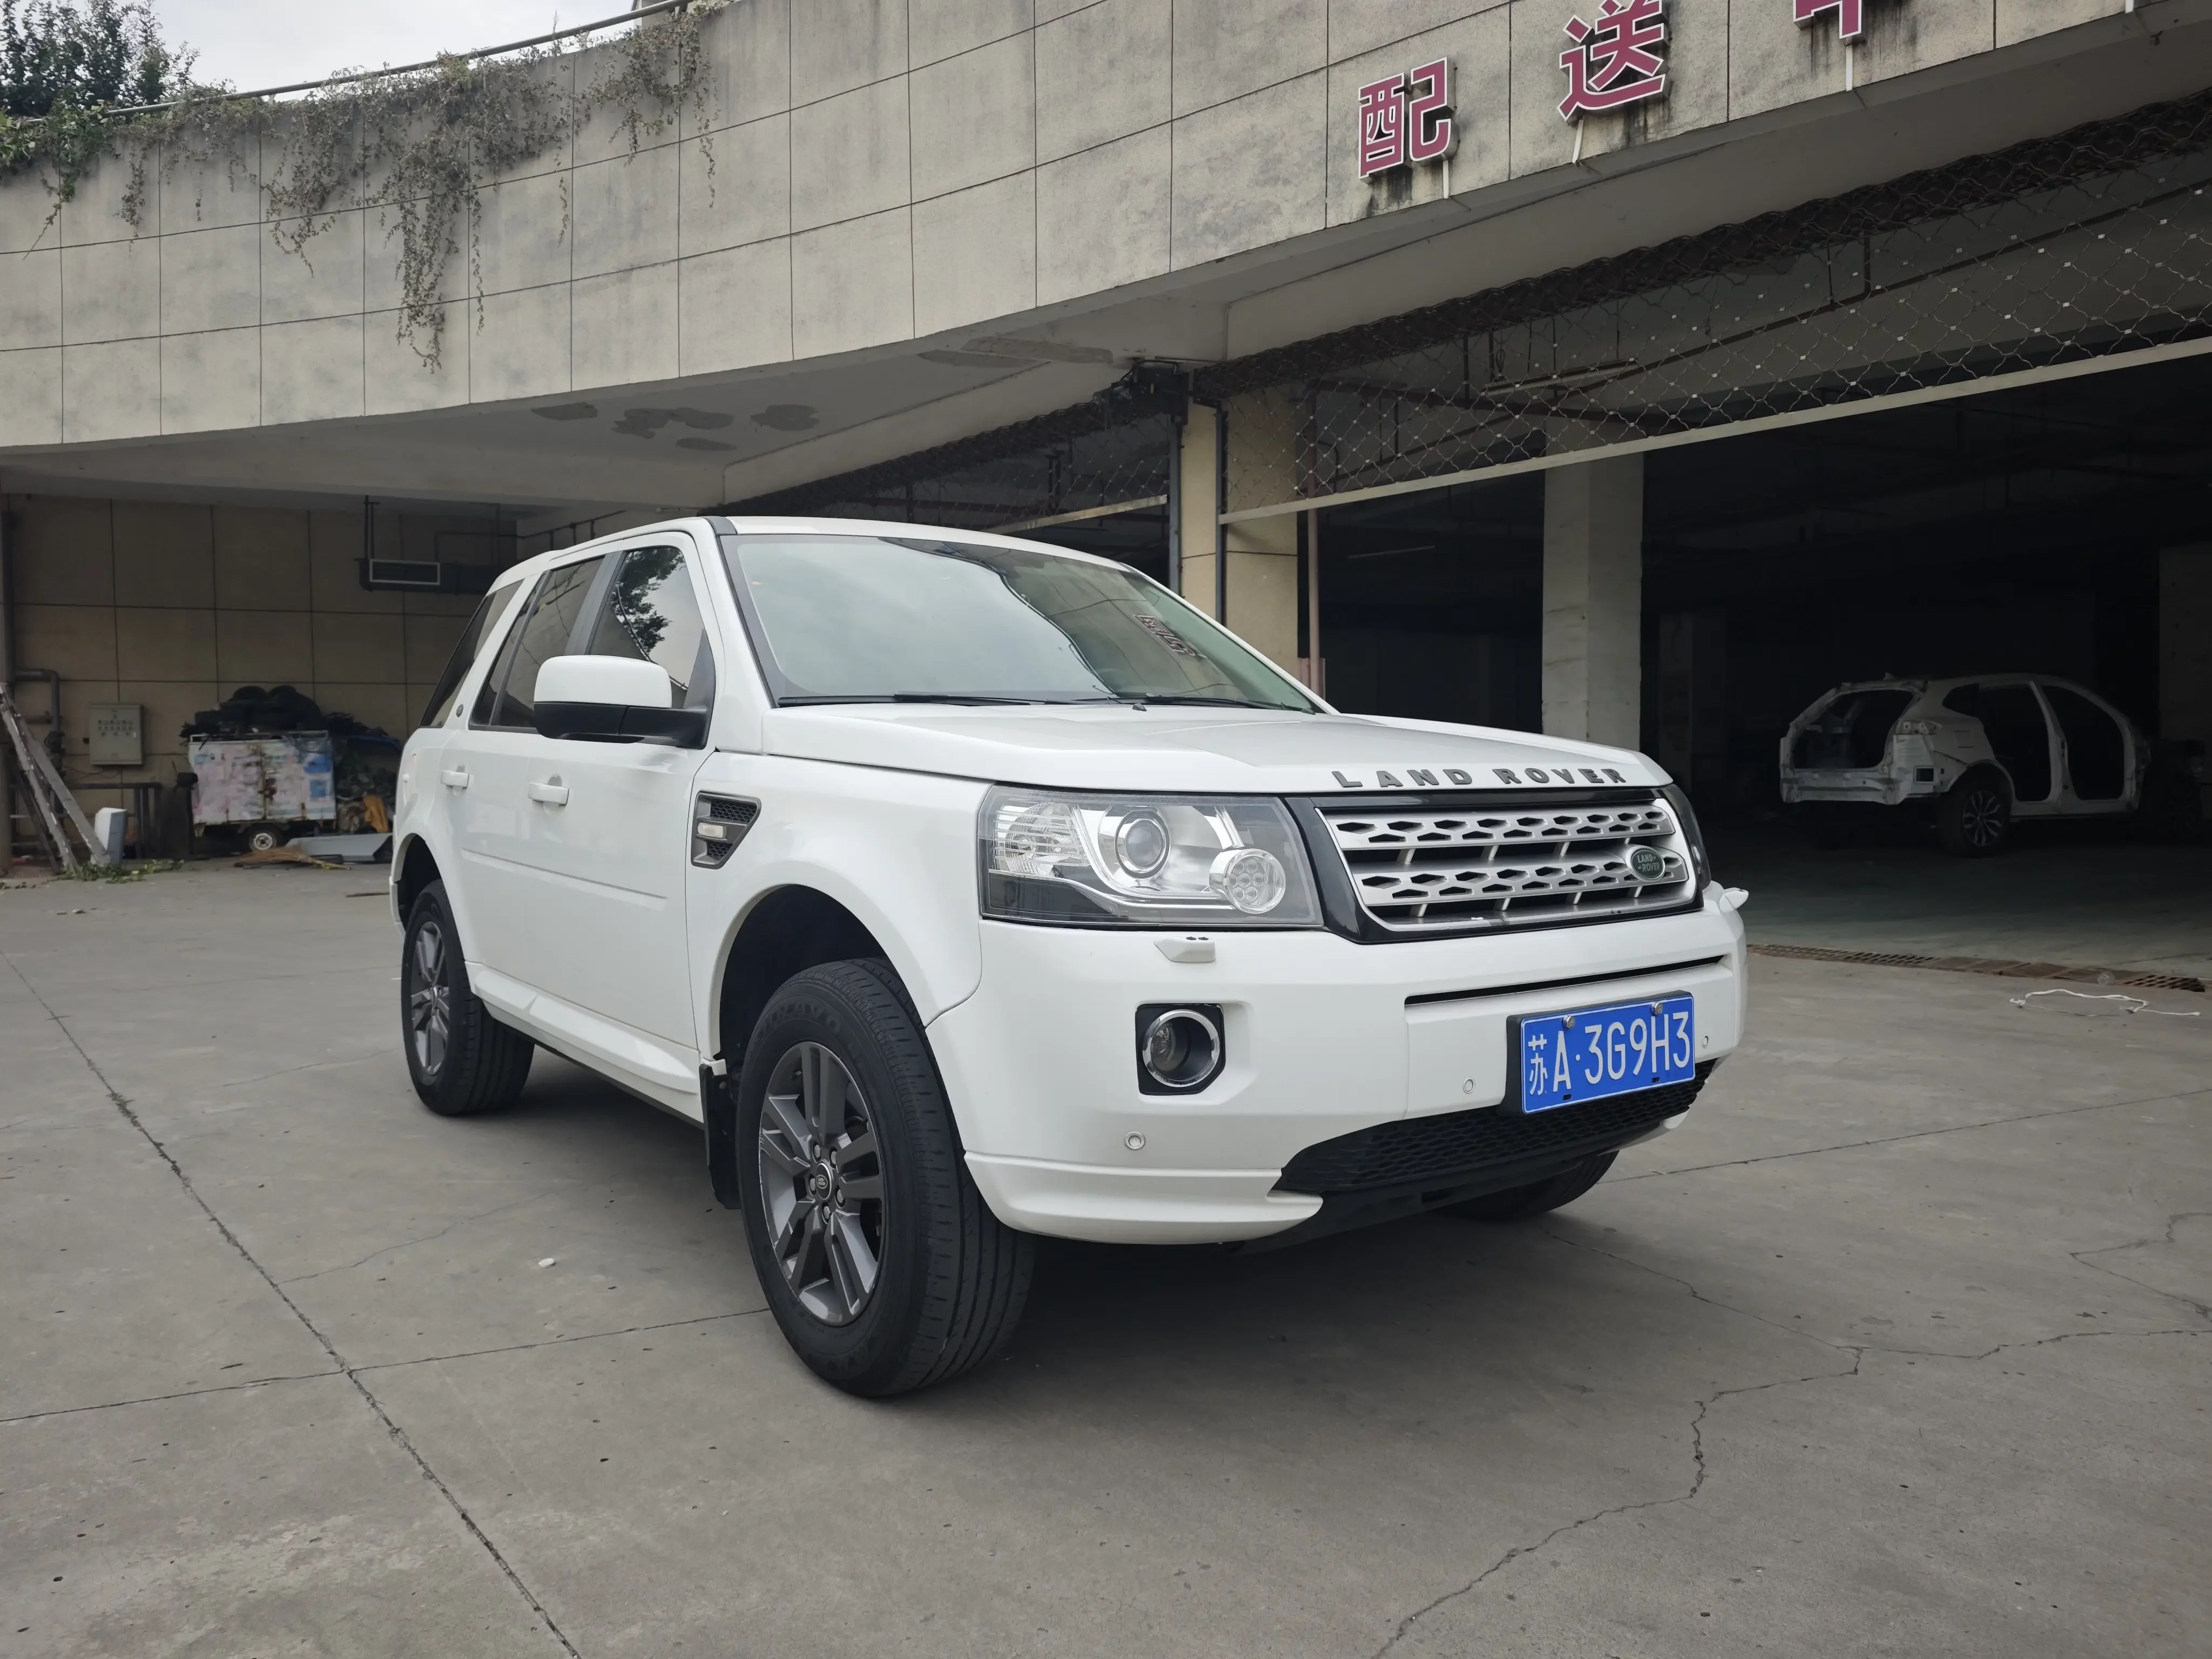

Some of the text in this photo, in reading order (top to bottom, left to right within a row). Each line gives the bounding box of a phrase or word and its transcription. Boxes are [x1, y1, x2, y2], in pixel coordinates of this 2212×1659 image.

[1332, 768, 1626, 788] LAND ROVER
[1637, 854, 1653, 863] LAND
[1642, 862, 1660, 872] ROVER
